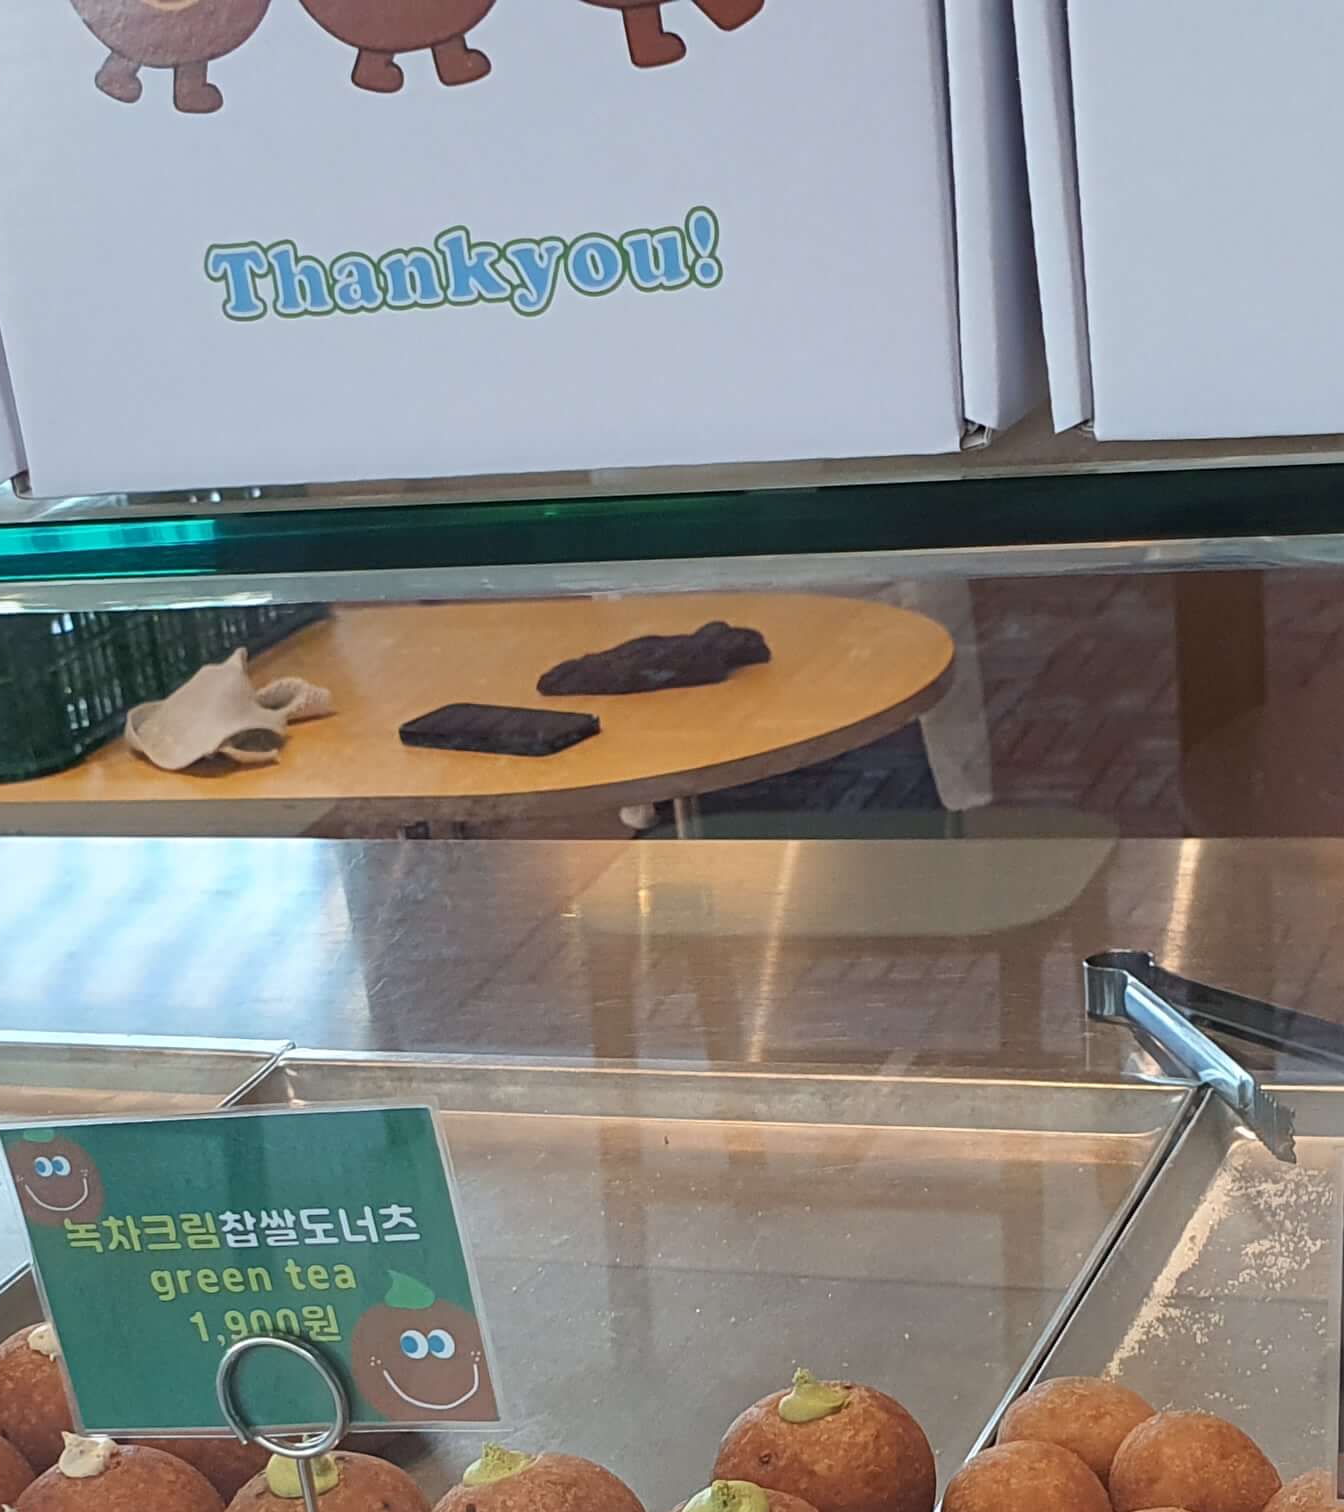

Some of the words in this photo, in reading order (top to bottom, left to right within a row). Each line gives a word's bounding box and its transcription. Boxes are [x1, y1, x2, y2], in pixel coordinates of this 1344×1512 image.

[205, 205, 724, 322] Thankyou!
[63, 1203, 422, 1253] 녹차크림찹쌀도너츠
[149, 1265, 273, 1302] green
[284, 1259, 358, 1290] tea
